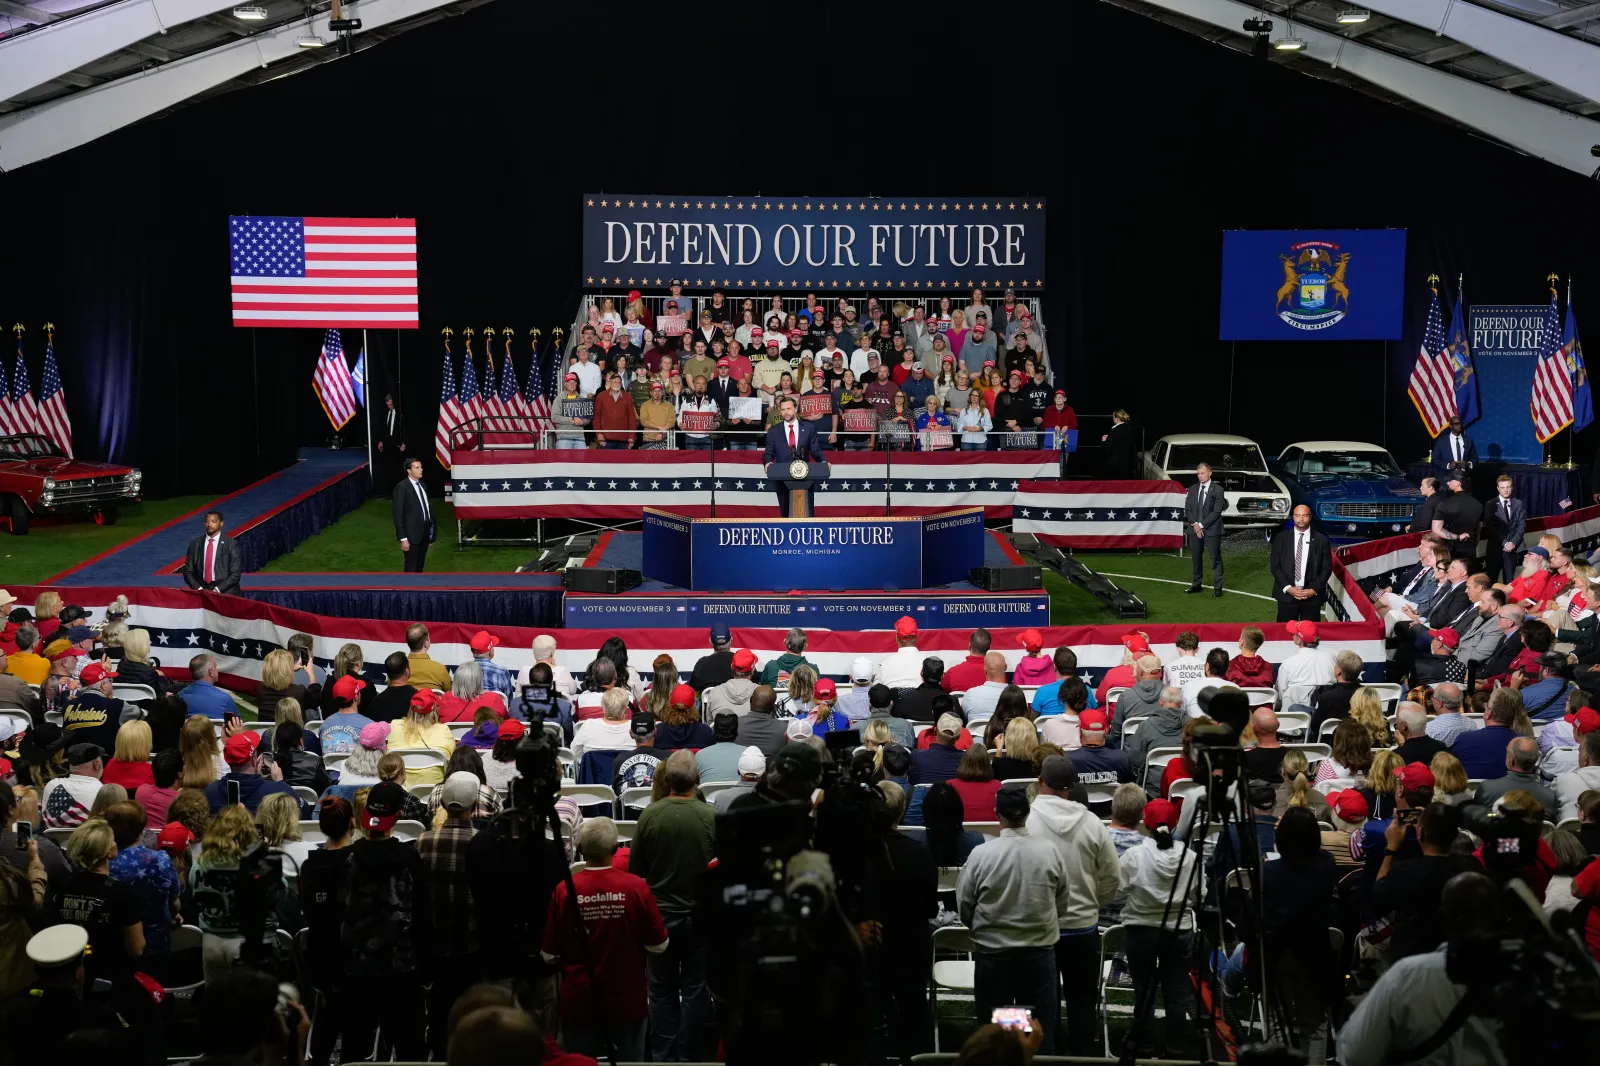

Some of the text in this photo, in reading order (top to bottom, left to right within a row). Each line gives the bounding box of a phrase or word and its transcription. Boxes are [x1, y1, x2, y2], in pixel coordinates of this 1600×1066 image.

[604, 222, 1026, 267] DEFEND OUR FUTURE
[1288, 319, 1337, 329] CIRCUMSPICE
[1474, 317, 1544, 329] DEFEND OUR
[1472, 330, 1544, 349] FUTURE
[564, 407, 593, 417] FUTURE
[801, 403, 831, 413] FUTURE
[845, 419, 876, 427] FUTURE
[1006, 436, 1037, 446] FUTURE
[646, 516, 656, 525] VOTE
[663, 521, 685, 532] NOVEMBER
[926, 523, 939, 531] VOTE
[949, 517, 976, 527] NOVEMBER
[719, 527, 894, 546] DEFEND OUR FUTURE
[582, 605, 671, 613] VOTE ON NOVEMBER 3
[704, 604, 791, 614] DEFEND OUR FUTURE
[944, 603, 1031, 613] DEFEND OUR FUTURE
[619, 759, 634, 775] SONS
[633, 754, 642, 762] OF
[1078, 771, 1118, 783] TOLEDO
[63, 897, 87, 910] DON'T
[577, 892, 626, 904] Socialist:
[74, 909, 90, 921] ONE
